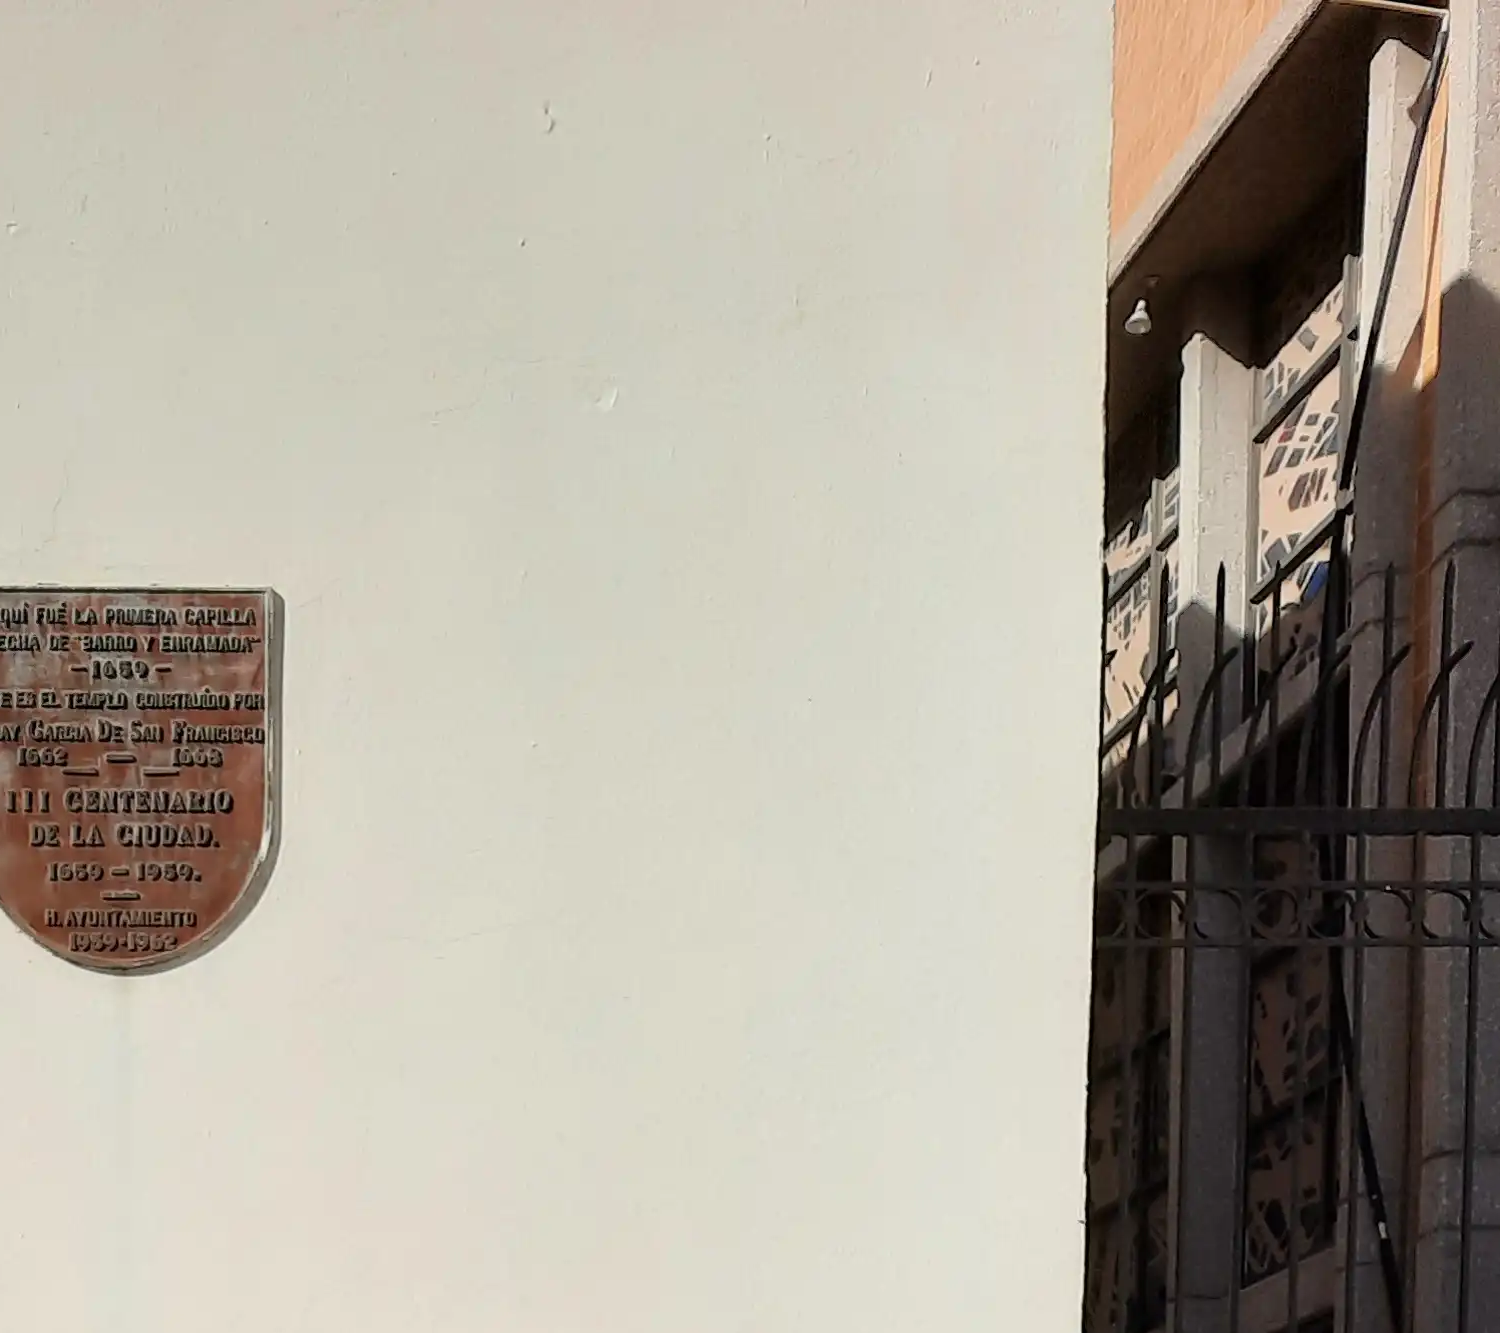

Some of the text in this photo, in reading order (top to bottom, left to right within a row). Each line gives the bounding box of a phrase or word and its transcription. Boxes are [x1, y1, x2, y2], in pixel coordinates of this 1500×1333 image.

[73, 606, 98, 626] LA
[104, 607, 177, 627] PRIMERA
[184, 607, 257, 627] CAPILLA
[48, 634, 70, 652] DE
[140, 634, 156, 653] Y
[15, 689, 37, 709] ES
[39, 689, 62, 709] EL
[65, 690, 128, 711] TEMPLO
[233, 692, 265, 711] POR
[6, 788, 235, 815] III CENTENARIO
[30, 824, 221, 849] DE LA CIUDAD.
[48, 862, 105, 882] 1659
[44, 909, 198, 929] H. AYUNTAMIENTO
